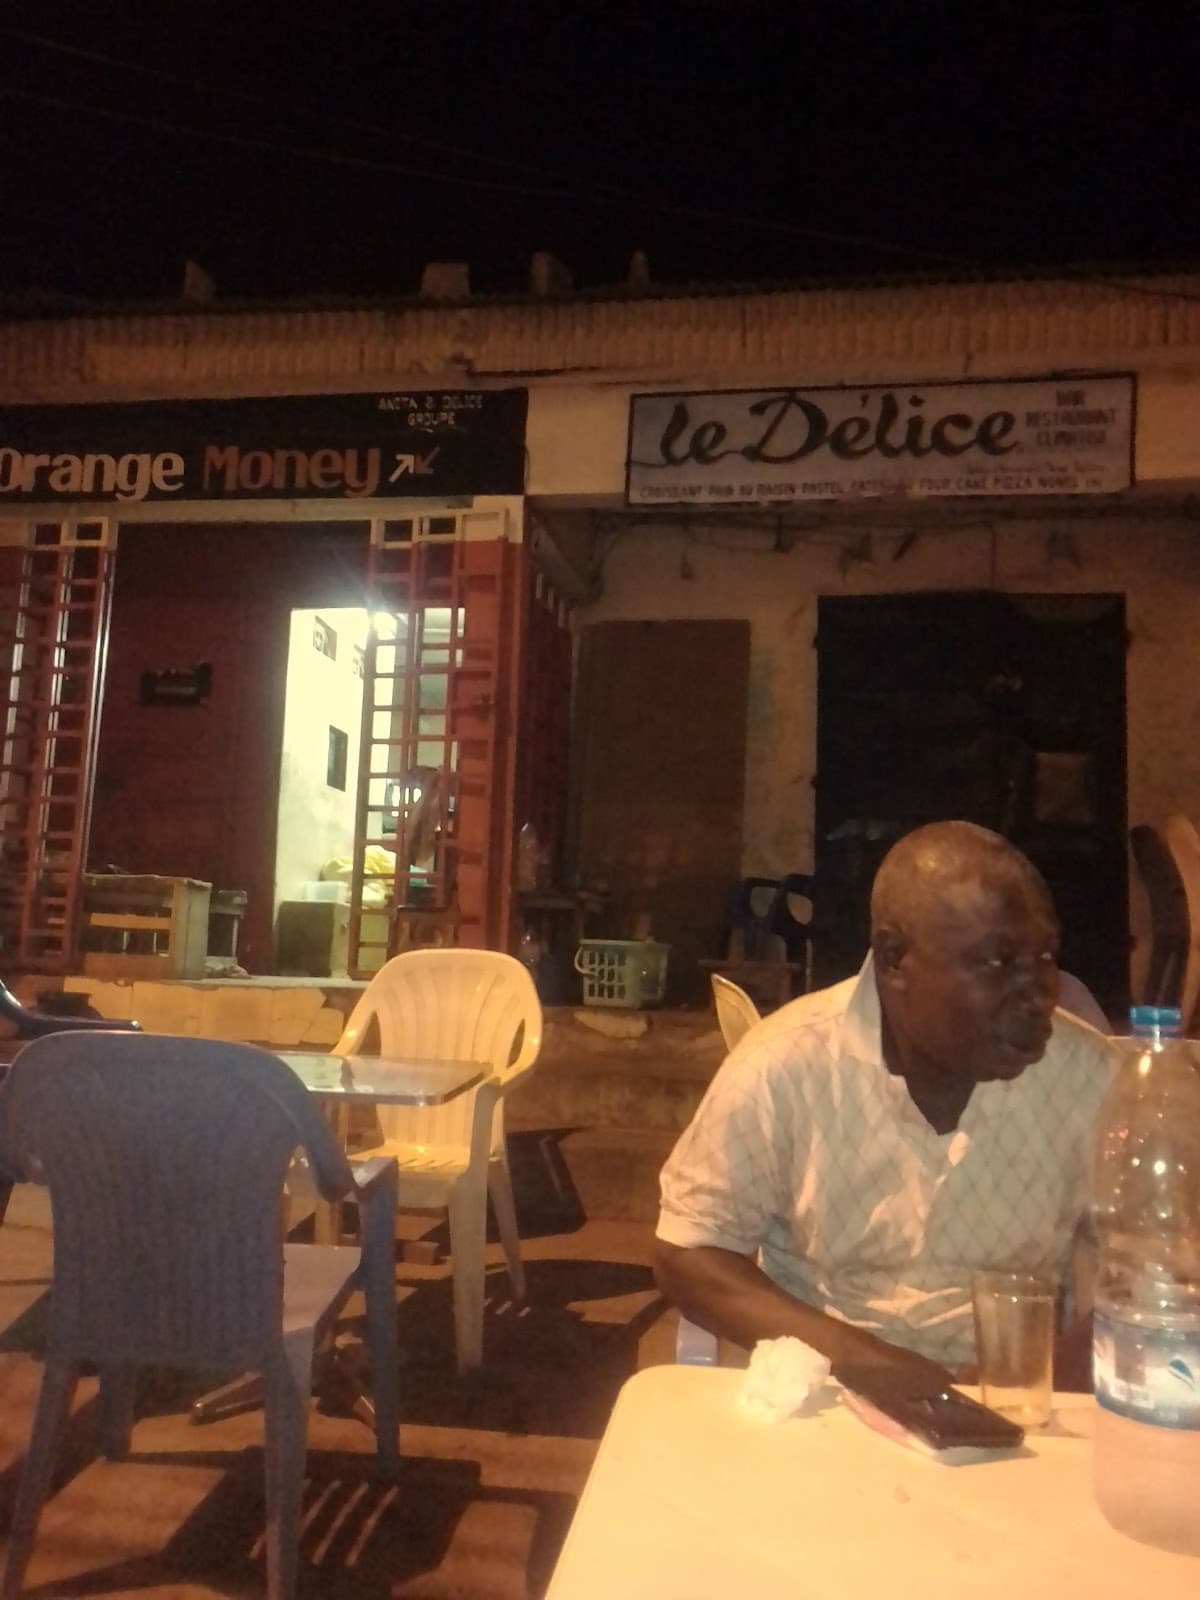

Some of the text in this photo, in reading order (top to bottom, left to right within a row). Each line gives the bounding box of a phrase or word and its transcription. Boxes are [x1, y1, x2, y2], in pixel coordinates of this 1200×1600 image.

[660, 391, 1020, 466] le Délice
[0, 444, 382, 503] Orange Money
